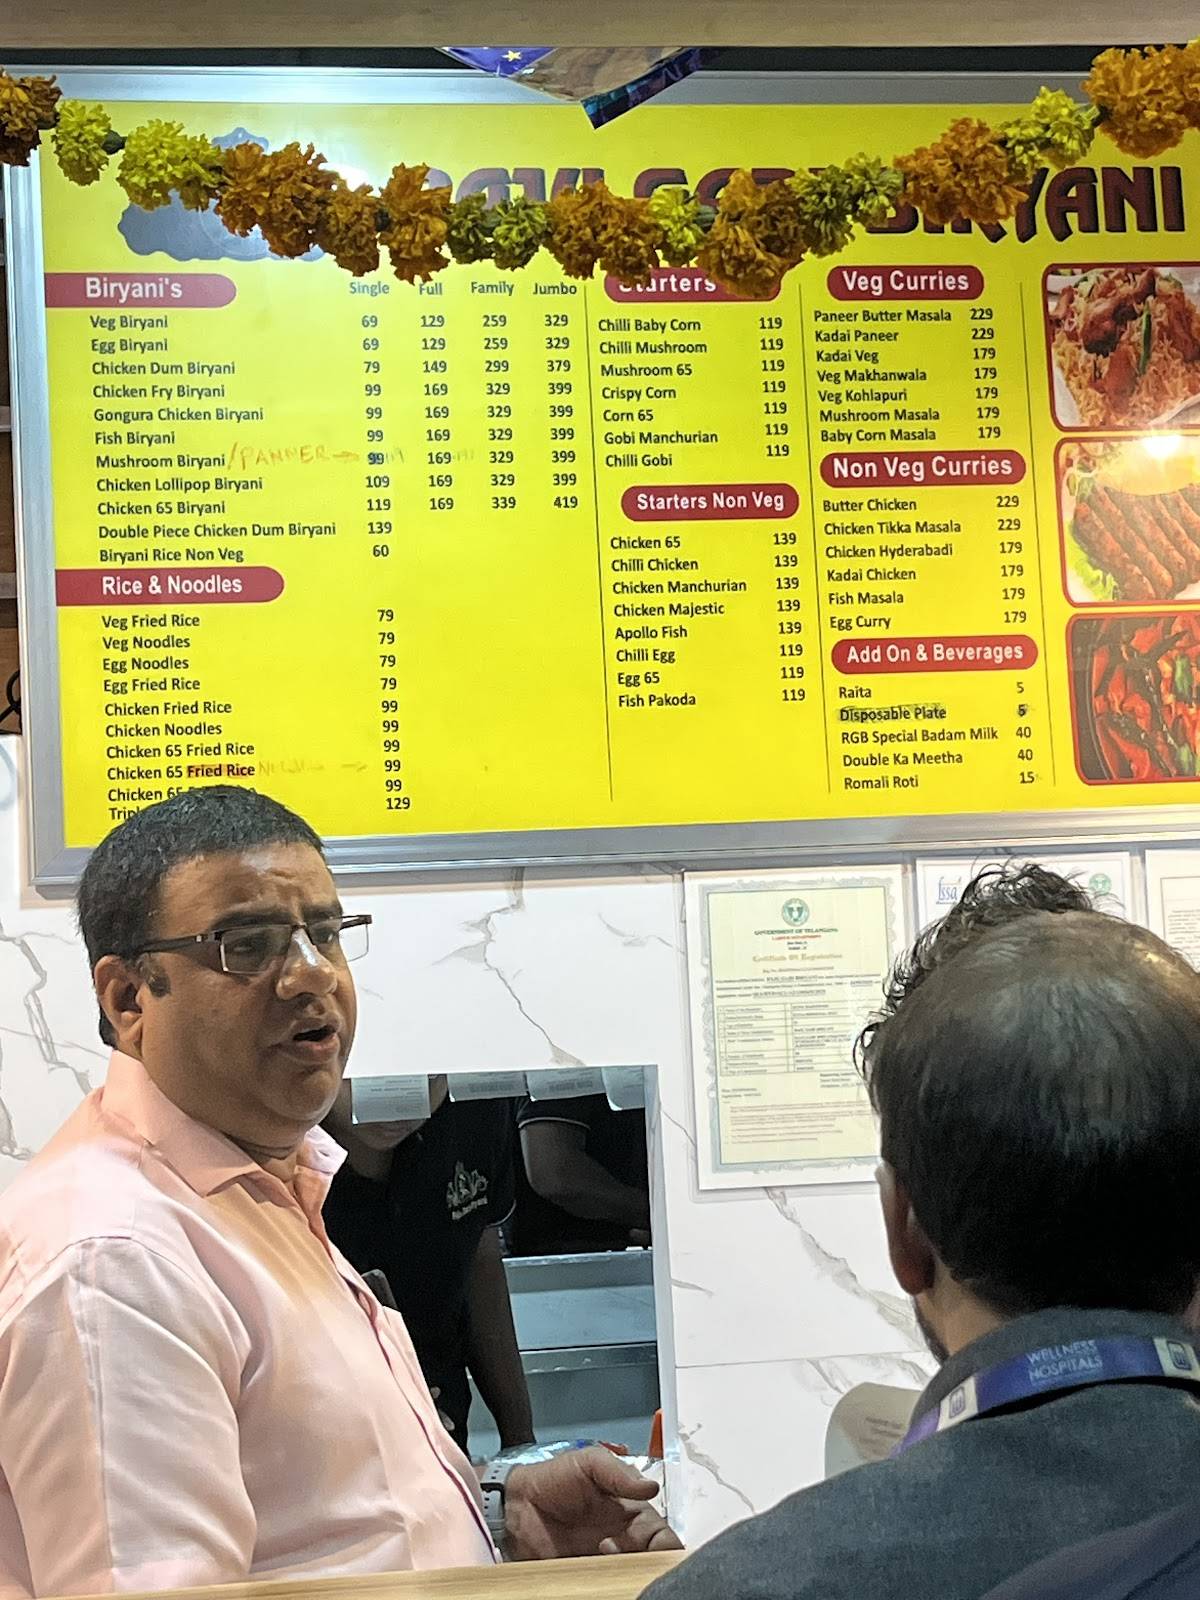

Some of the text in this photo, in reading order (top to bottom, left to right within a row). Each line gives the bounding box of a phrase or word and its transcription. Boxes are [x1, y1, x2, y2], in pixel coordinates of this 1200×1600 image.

[866, 166, 1185, 243] YANI
[86, 277, 182, 303] Biryani's
[349, 280, 577, 297] Single Full Family Jumbo
[842, 270, 968, 296] Veg Curries
[89, 314, 568, 331] Veg Biryani 69 129 259 329
[814, 308, 993, 322] Paneer Butter Masala 229
[598, 316, 782, 334] Chilli Baby Corn 119
[816, 347, 996, 364] Kadai Veg 179
[92, 359, 571, 377] Chicken Dum Biryani 79 149 299 379
[600, 359, 785, 376] Mushroom 65 119
[816, 367, 997, 385] Veg Makhanwala 179
[602, 380, 786, 402] Crispy Corn 119
[93, 405, 573, 424] Gongura Chicken Biryani 99 169 329 399
[819, 406, 1000, 422] Mushroom Masala 179
[604, 423, 788, 444] Gobi Manchurian 119
[96, 454, 173, 468] Mushroom
[176, 454, 225, 470] Biryani
[427, 451, 451, 464] 169
[489, 450, 514, 463] 329
[551, 450, 576, 463] 399
[833, 455, 1012, 482] Non Veg Curries
[96, 473, 577, 494] Chicken Lollipop Biryani 109 169 329 399
[637, 491, 784, 511] Starters Non Veg
[823, 495, 1019, 512] Butter Chicken 229
[98, 521, 392, 538] Double Piece Chicken Dum Biryani 139
[824, 518, 1020, 535] Chicken Tikka Masala 229
[825, 541, 1022, 560] Chicken Hyderabadi 179
[611, 554, 798, 572] Chilli Chicken 139
[102, 574, 242, 595] Rice & Noodles
[612, 577, 799, 594] Chicken Manchurian 139
[614, 599, 800, 618] Chicken Majestic 139
[101, 609, 394, 631] Veg Fried Rice 79
[829, 610, 1027, 631] Egg Curry 179
[614, 621, 802, 642] Apollo Fish 139
[847, 643, 1023, 664] Add On & Beverages
[102, 654, 396, 674] Egg Noodles 79
[617, 666, 804, 687] Egg 65 119
[838, 681, 1024, 698] Raita 5
[105, 719, 399, 738] Chicken Noodles 99
[841, 726, 1031, 746] RGB Special Badam Milk 40
[843, 748, 1033, 767] Double Ka Meetha 40
[107, 766, 162, 780] Chicken
[166, 765, 183, 778] 65
[187, 763, 222, 778] Fried
[226, 763, 255, 777] Rice
[384, 759, 401, 772] 99
[844, 771, 1035, 789] Romali Roti 15
[1029, 1355, 1103, 1380] HOSPITALS
